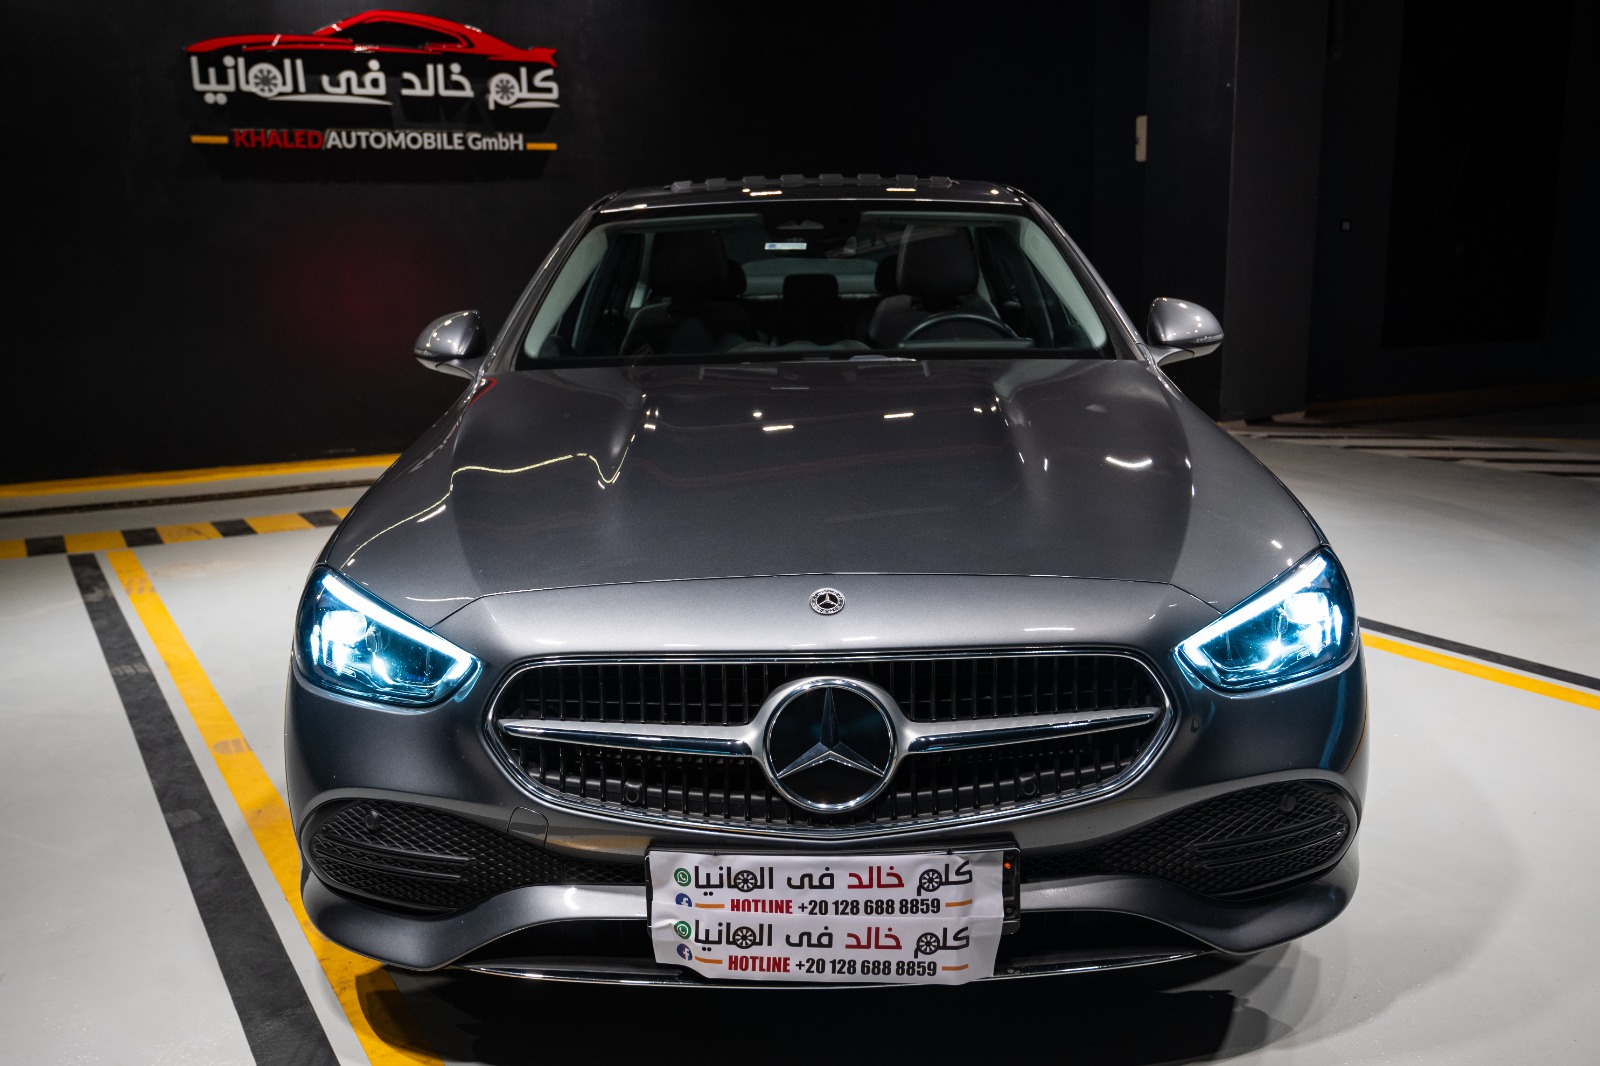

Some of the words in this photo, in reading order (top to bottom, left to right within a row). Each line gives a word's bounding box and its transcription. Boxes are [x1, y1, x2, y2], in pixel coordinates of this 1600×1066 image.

[401, 62, 475, 98] خالد
[234, 130, 323, 149] KHALED
[326, 131, 465, 151] AUTOMOBILE
[467, 132, 524, 151] GmbH
[847, 866, 905, 889] خالد
[730, 899, 793, 915] HOTLINE
[798, 899, 829, 916] +20
[832, 899, 860, 916] 128
[863, 899, 895, 916] 688
[898, 898, 941, 915] 8859
[845, 926, 903, 950] خالد
[728, 955, 791, 973] HOTLINE
[795, 957, 826, 975] +20
[829, 958, 857, 975] 128
[860, 959, 892, 976] 688
[895, 960, 938, 977] 8859
